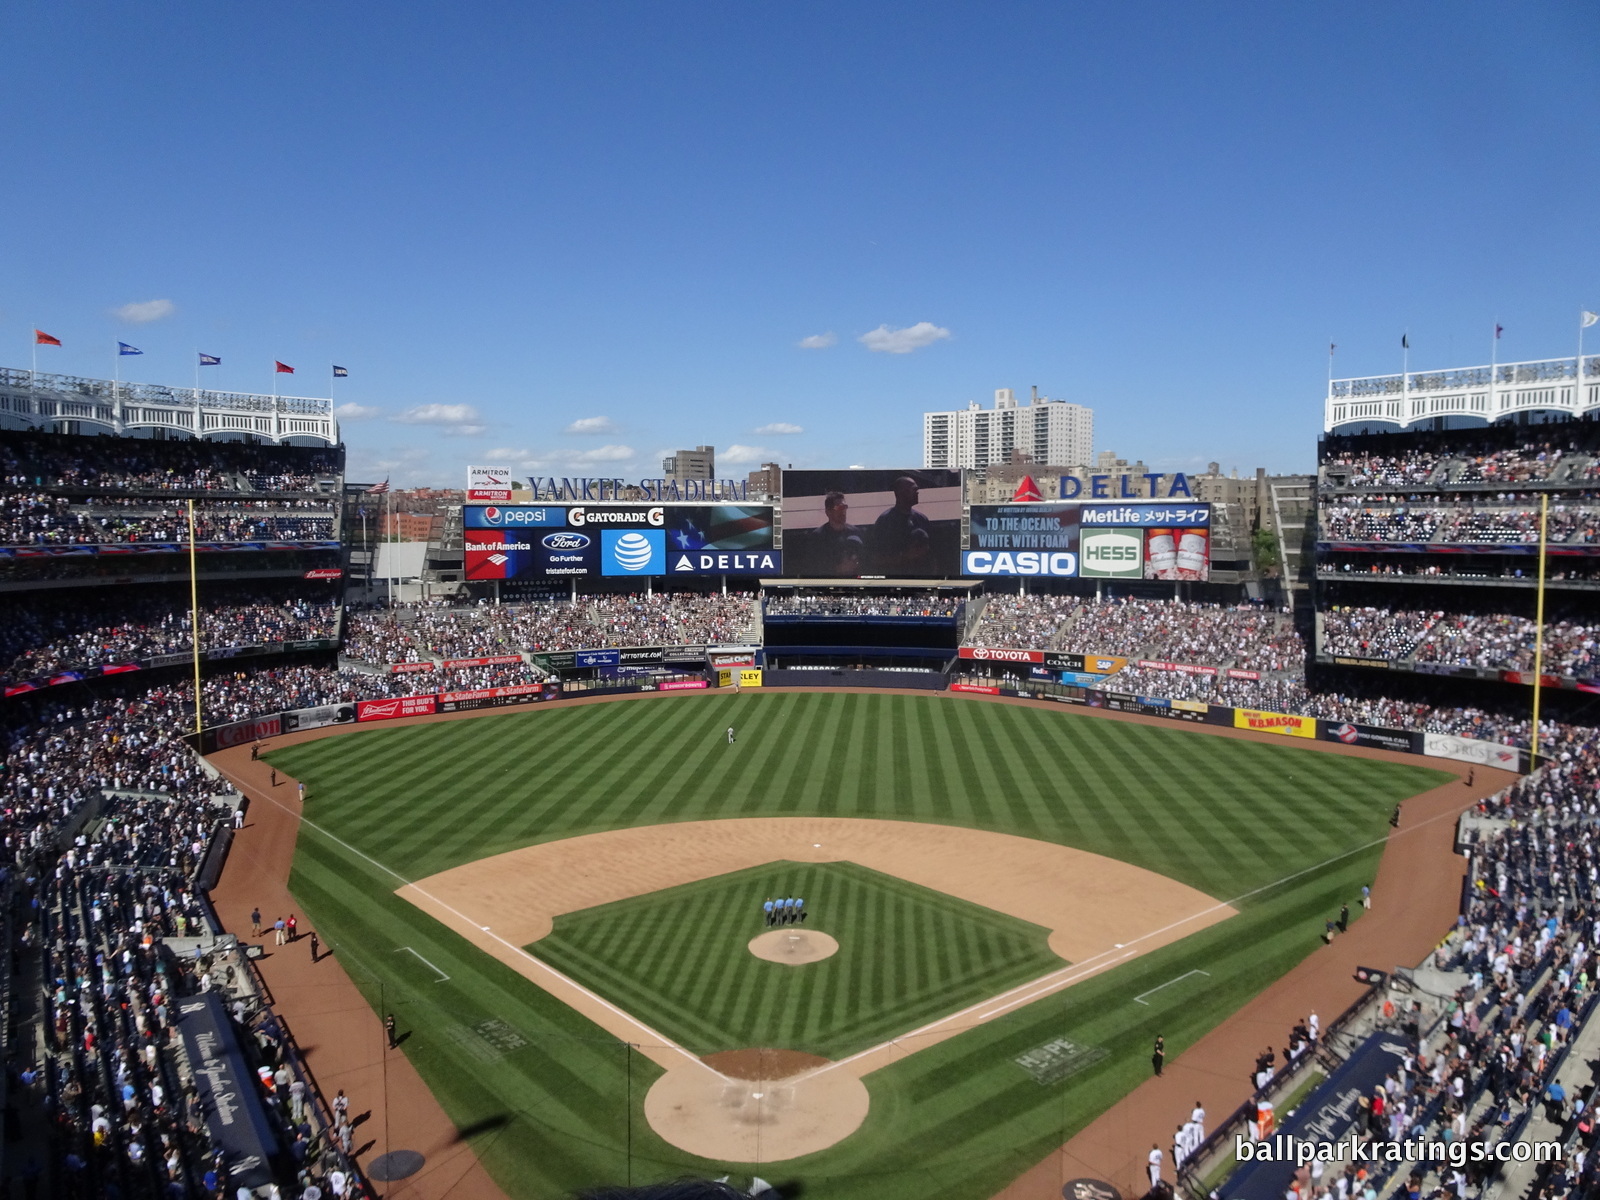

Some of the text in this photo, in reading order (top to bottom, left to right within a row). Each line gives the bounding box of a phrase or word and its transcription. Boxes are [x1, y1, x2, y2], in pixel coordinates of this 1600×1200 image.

[527, 477, 747, 500] YANKEE STADIUM
[1060, 472, 1193, 499] DELTA
[504, 509, 546, 524] pepsi
[586, 512, 646, 522] GATORADE
[1082, 508, 1209, 523] MetLife メットライフ
[986, 518, 1064, 533] TO THE OCEANS,
[465, 542, 530, 551] Bank of America
[551, 535, 580, 548] Ford
[978, 534, 1068, 548] WHITE WITH FOAM
[1086, 546, 1136, 560] HESS
[700, 555, 774, 569] DELTA
[967, 552, 1076, 575] CASIO
[620, 652, 662, 660] NITTOTIRE.COM
[990, 650, 1030, 660] TOYOTA
[1046, 660, 1082, 668] COACH
[1097, 660, 1112, 669] SAP
[364, 706, 396, 714] Budweiser
[217, 720, 280, 746] Canon
[1455, 744, 1491, 759] TRUST
[1304, 1112, 1336, 1140] York
[1321, 1088, 1361, 1122] Yankees
